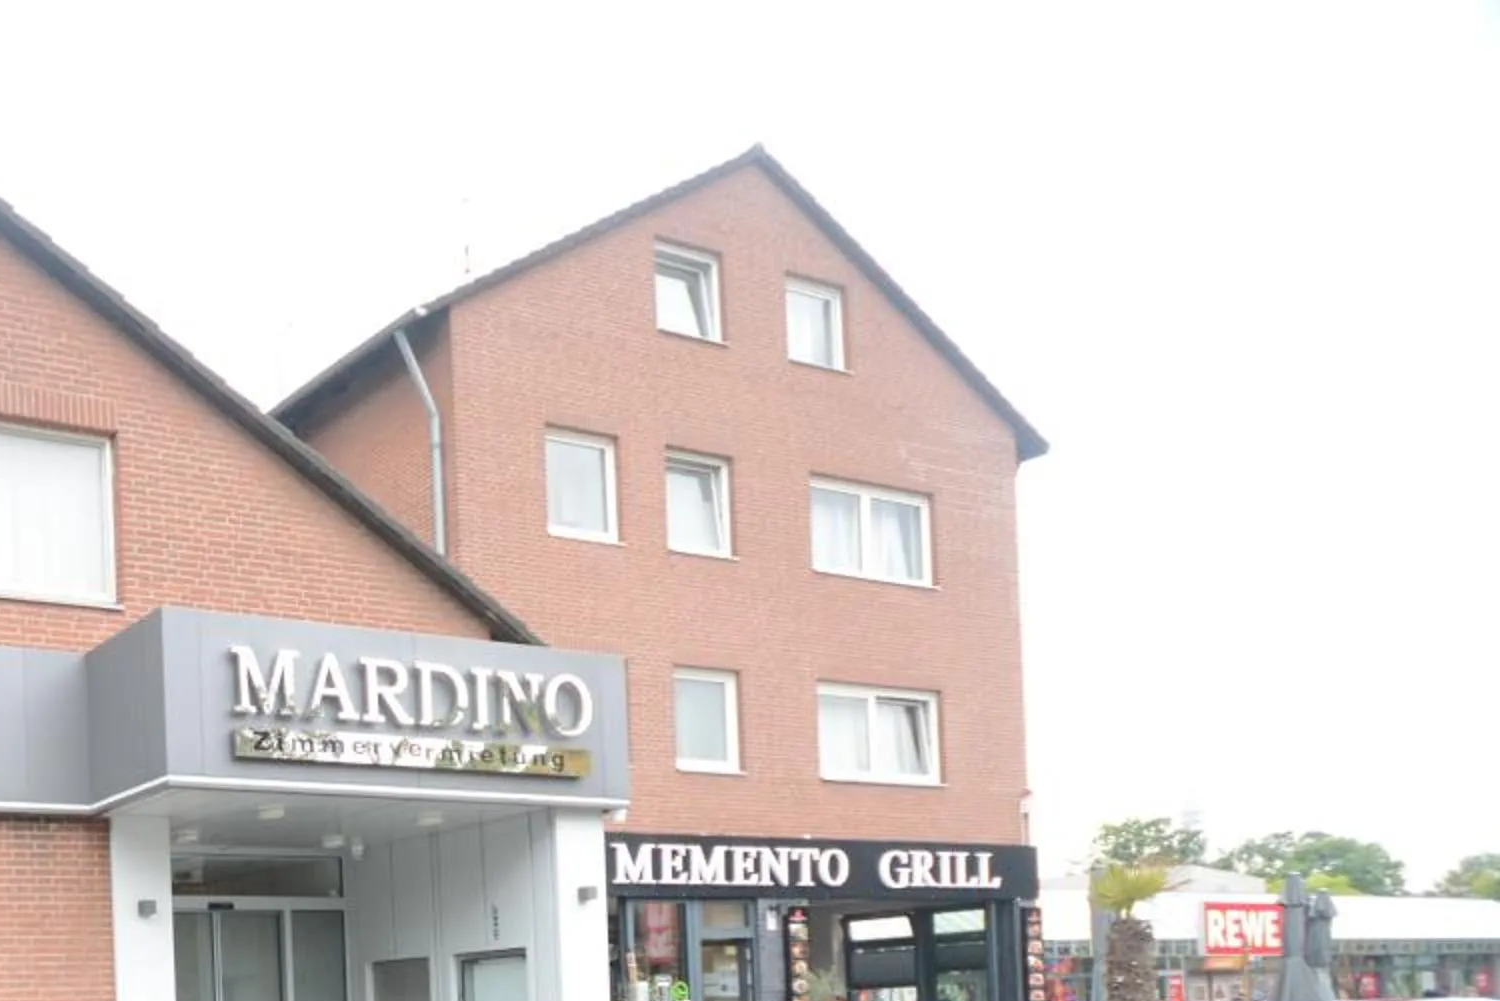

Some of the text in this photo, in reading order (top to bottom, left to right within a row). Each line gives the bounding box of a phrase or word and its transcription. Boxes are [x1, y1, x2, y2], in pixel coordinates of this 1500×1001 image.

[228, 645, 593, 738] MARDINO
[610, 843, 1003, 888] MEMENTO GRILL
[1205, 908, 1283, 948] REWE
